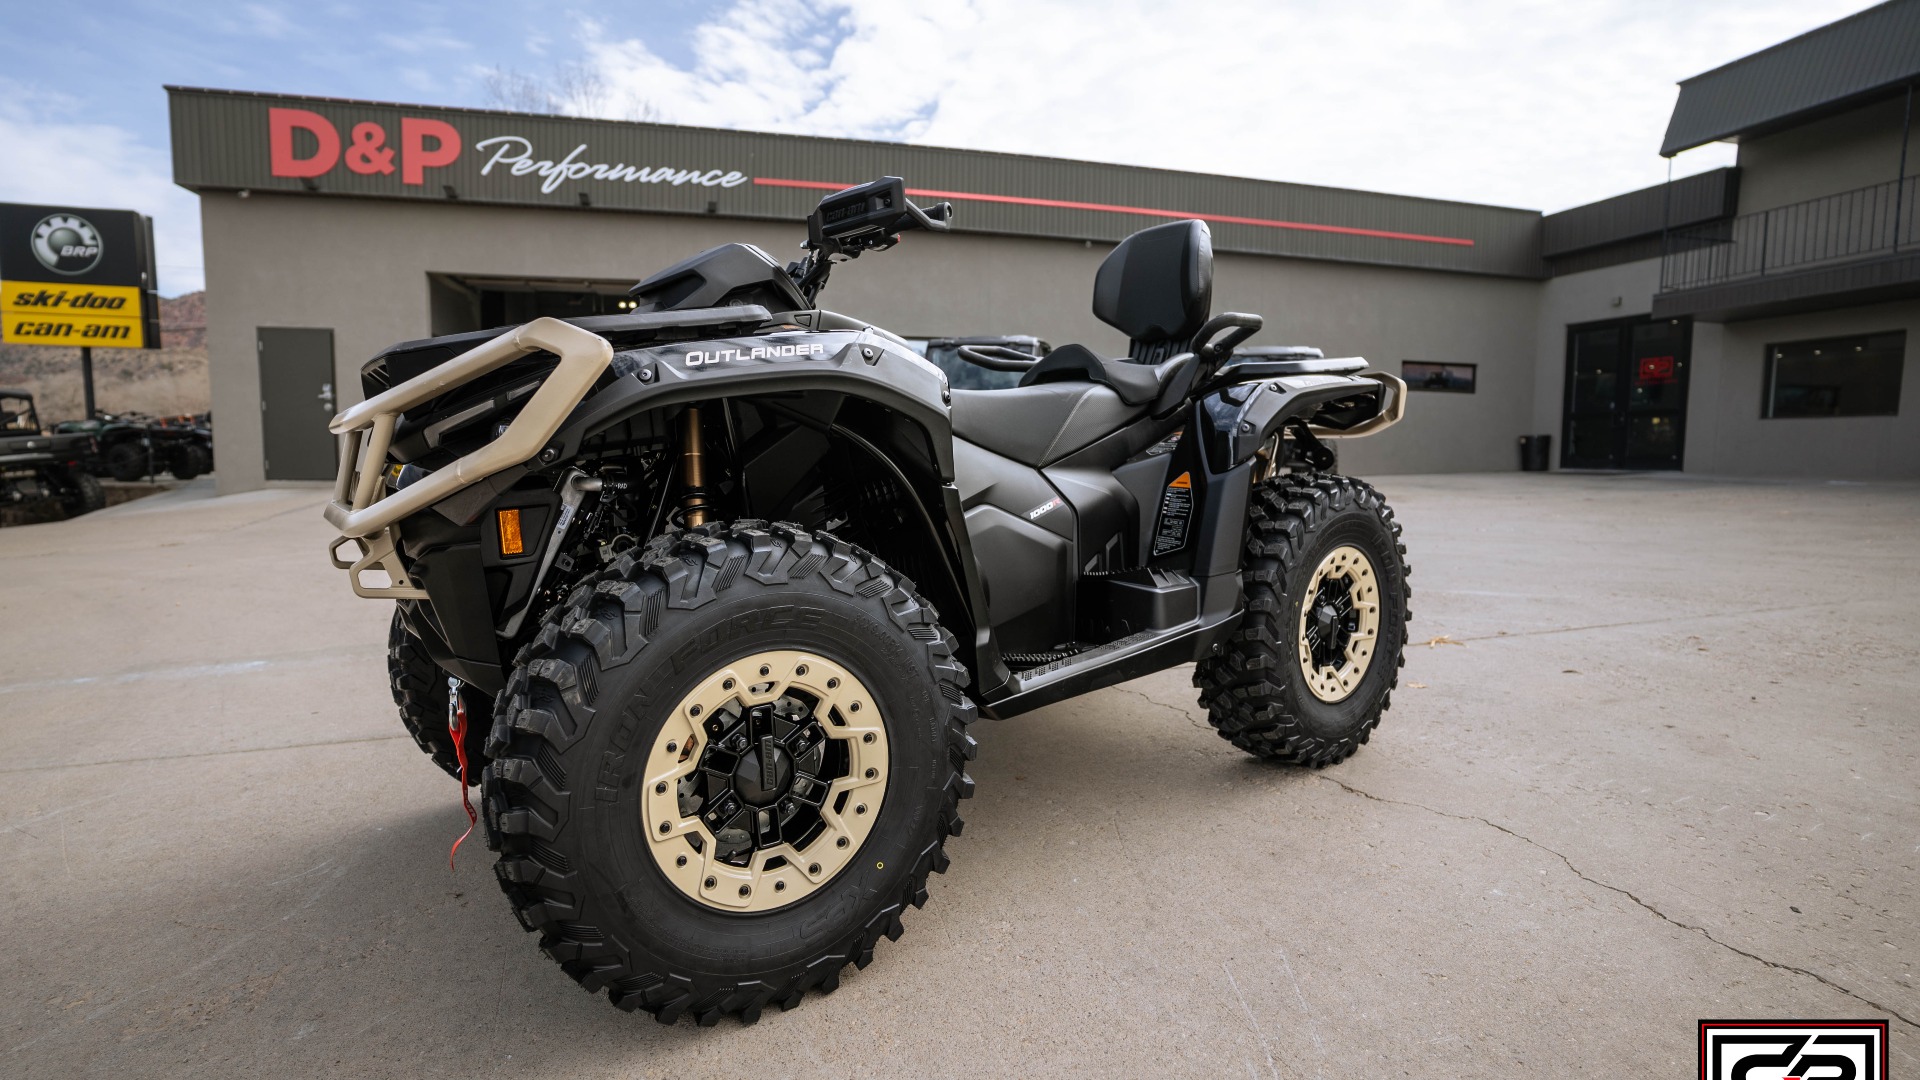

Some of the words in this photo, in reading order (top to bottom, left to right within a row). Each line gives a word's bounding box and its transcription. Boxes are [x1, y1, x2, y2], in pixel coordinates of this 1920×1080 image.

[269, 107, 462, 185] D&P
[475, 135, 748, 194] Performance
[61, 245, 98, 257] BRP
[13, 290, 126, 309] ski-doo
[14, 321, 130, 339] can-am
